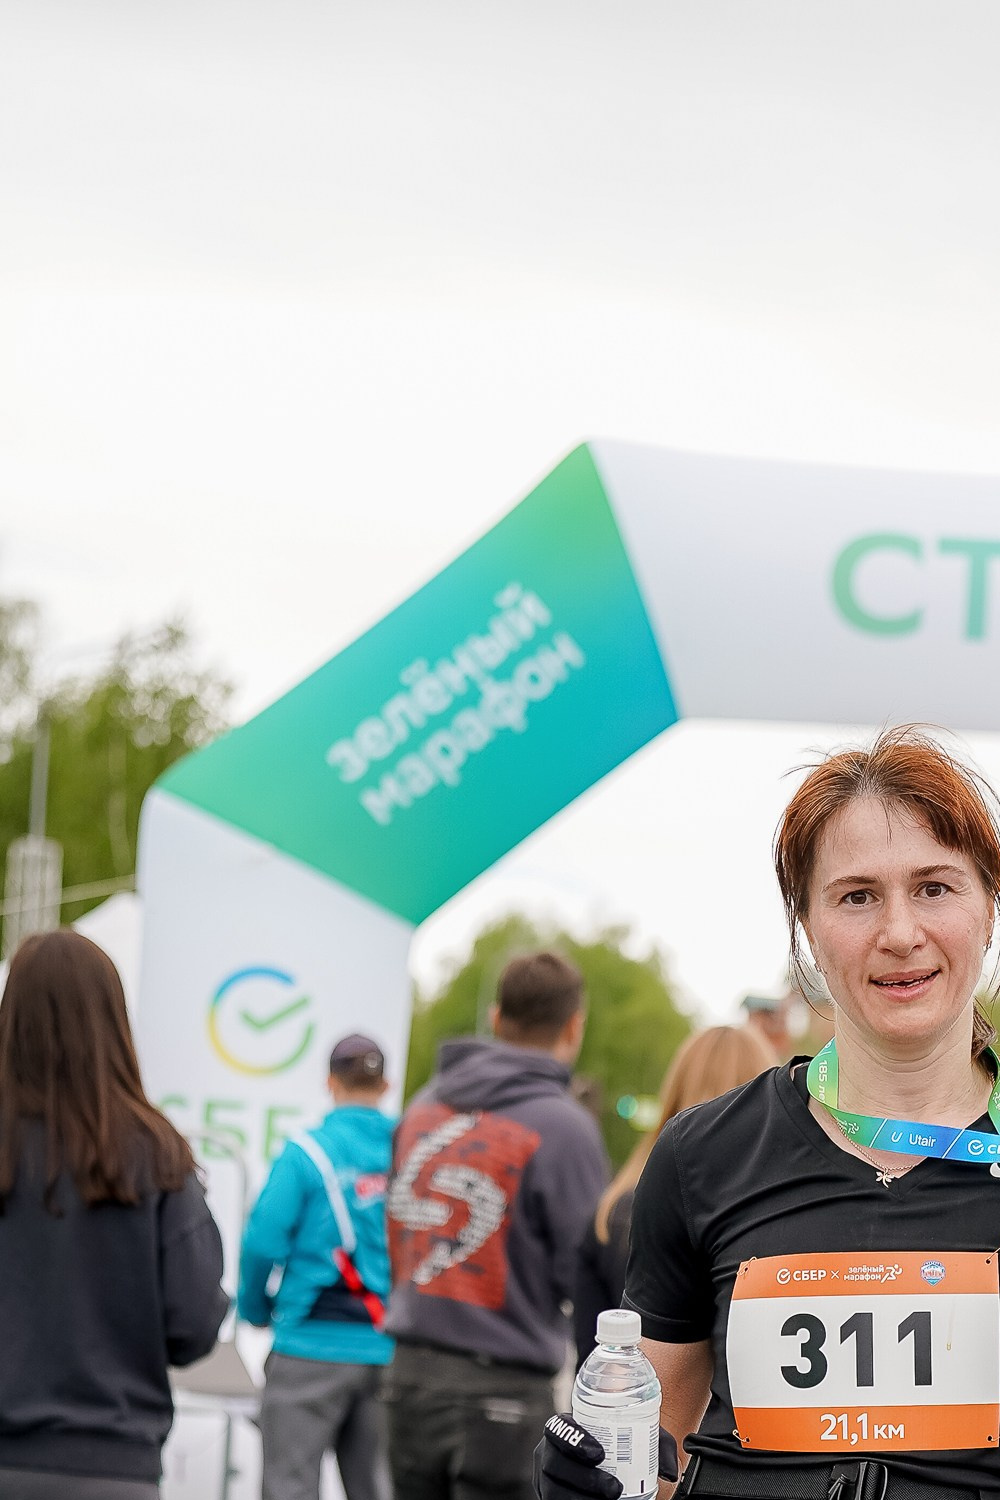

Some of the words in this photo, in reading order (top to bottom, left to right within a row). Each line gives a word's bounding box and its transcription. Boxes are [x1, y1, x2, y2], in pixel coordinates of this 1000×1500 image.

[325, 581, 552, 783] зелёный
[359, 630, 586, 826] марафон
[818, 1059, 828, 1082] 185
[909, 1133, 937, 1148] Utair
[793, 1269, 827, 1281] СБЕР
[843, 1273, 882, 1282] марафон
[848, 1264, 885, 1274] зелёный
[780, 1311, 933, 1389] 311
[820, 1412, 868, 1445] 21,1
